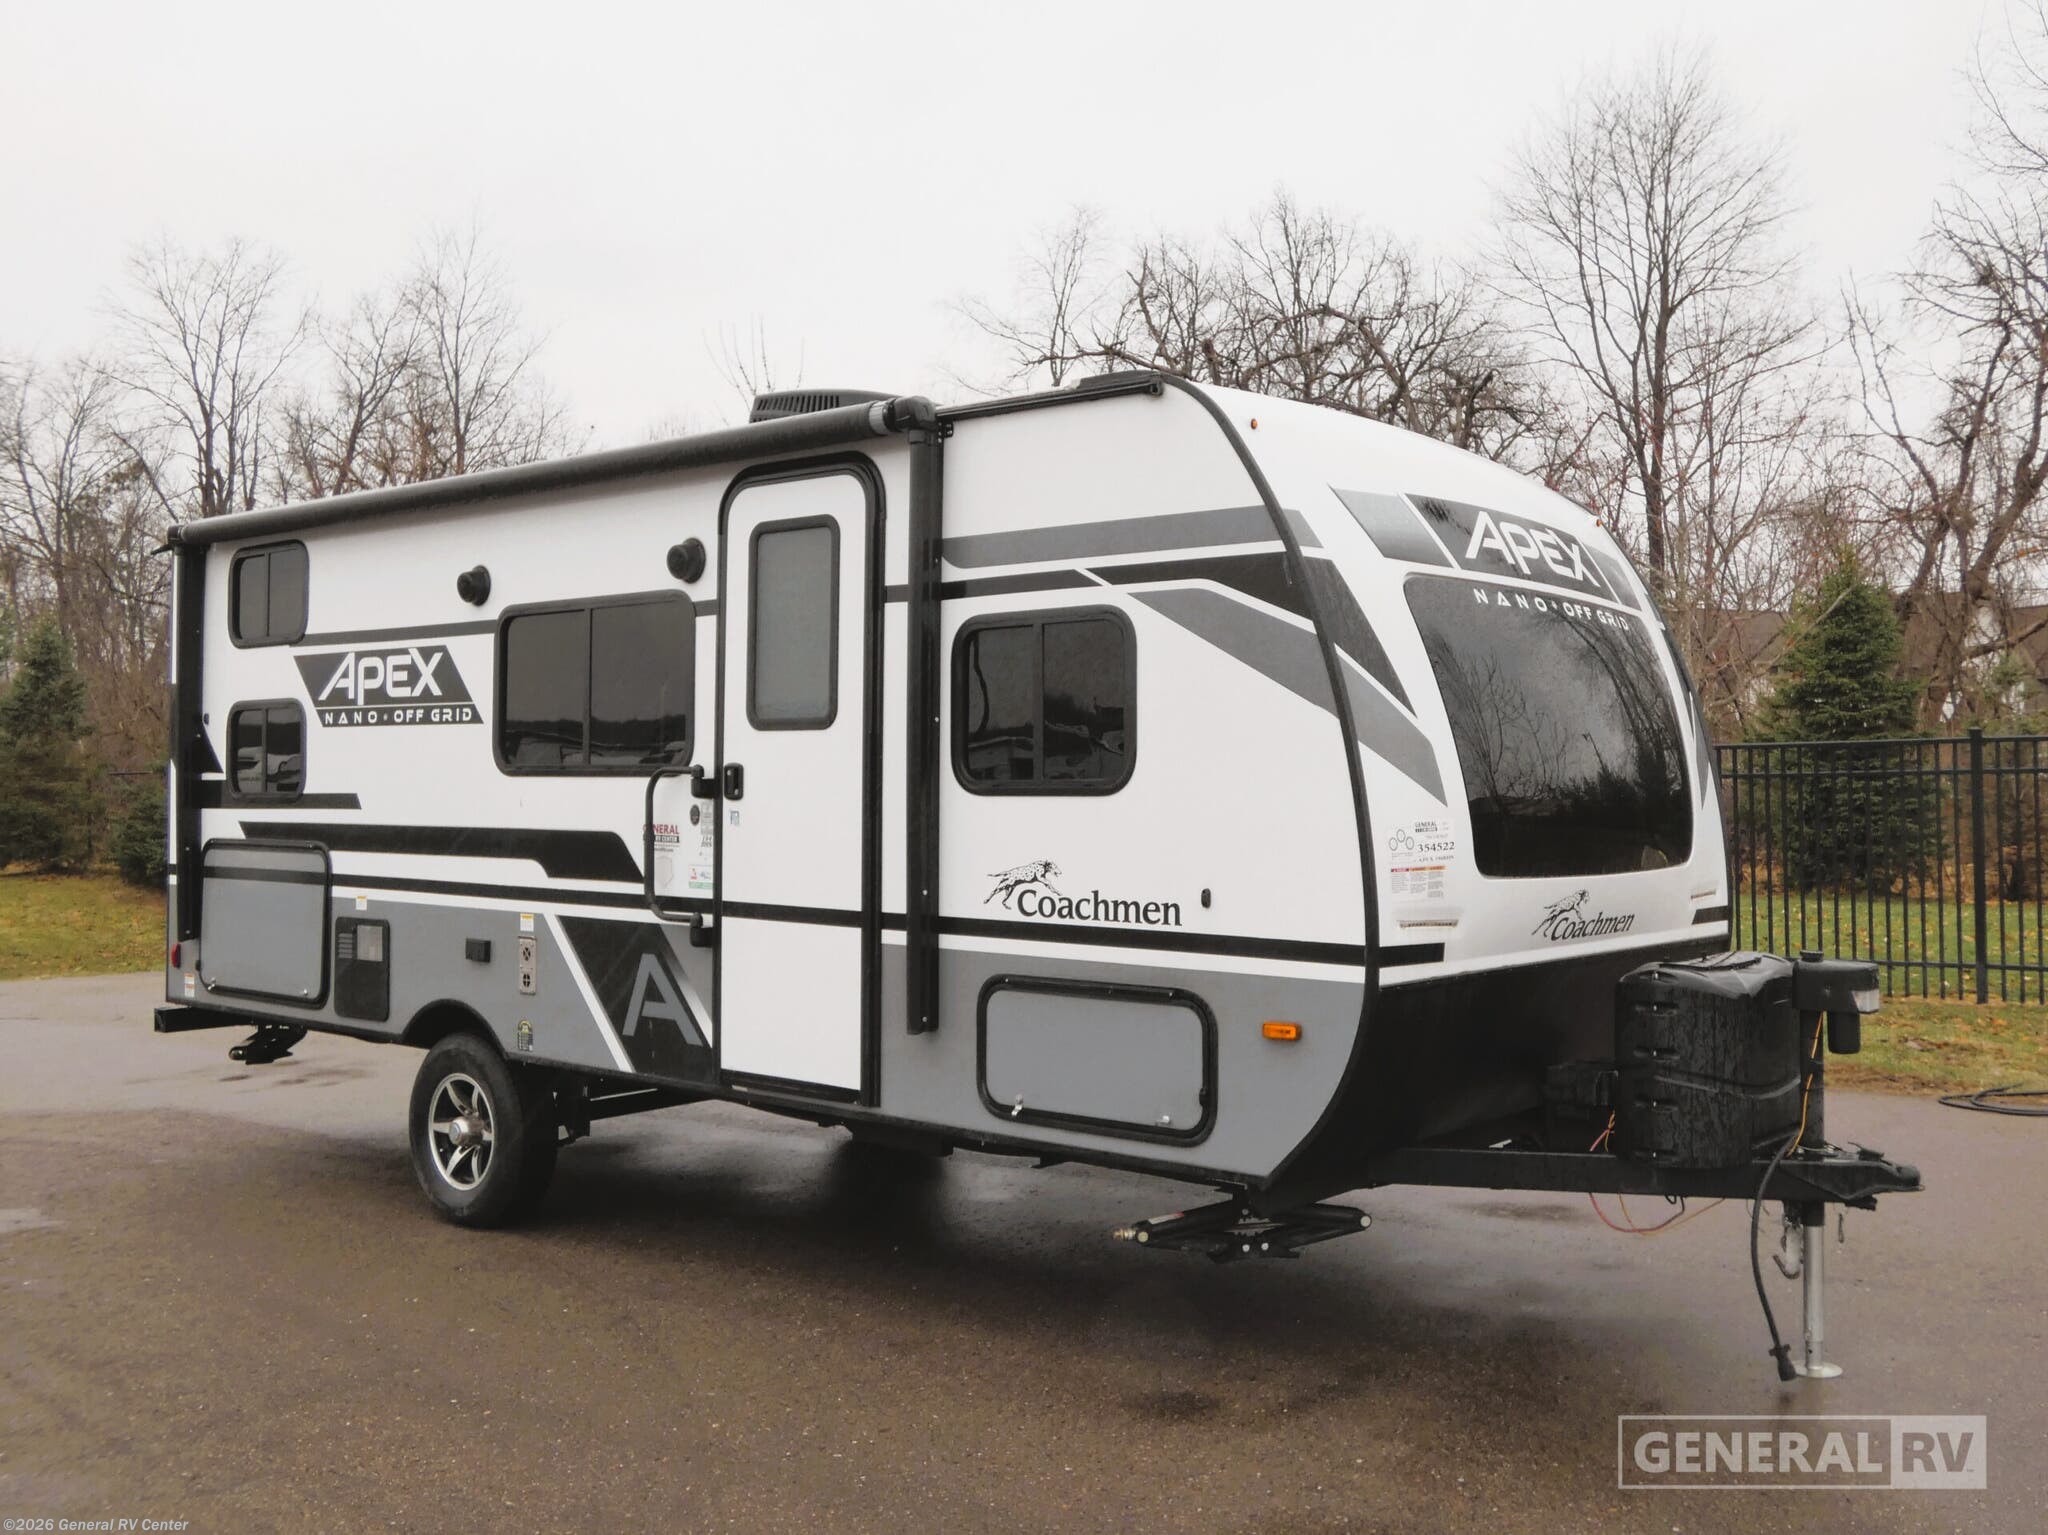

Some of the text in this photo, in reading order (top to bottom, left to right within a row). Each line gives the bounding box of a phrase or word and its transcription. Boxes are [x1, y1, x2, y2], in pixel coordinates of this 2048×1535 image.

[1465, 510, 1600, 588] APEX
[1473, 588, 1629, 631] NANO OFF GRID
[318, 647, 443, 706] APEX
[324, 707, 472, 725] NANO OFF GRID
[1417, 841, 1455, 853] 354522
[1017, 889, 1182, 926] Coachmen
[1551, 911, 1635, 942] Coachmen
[622, 952, 704, 1048] A
